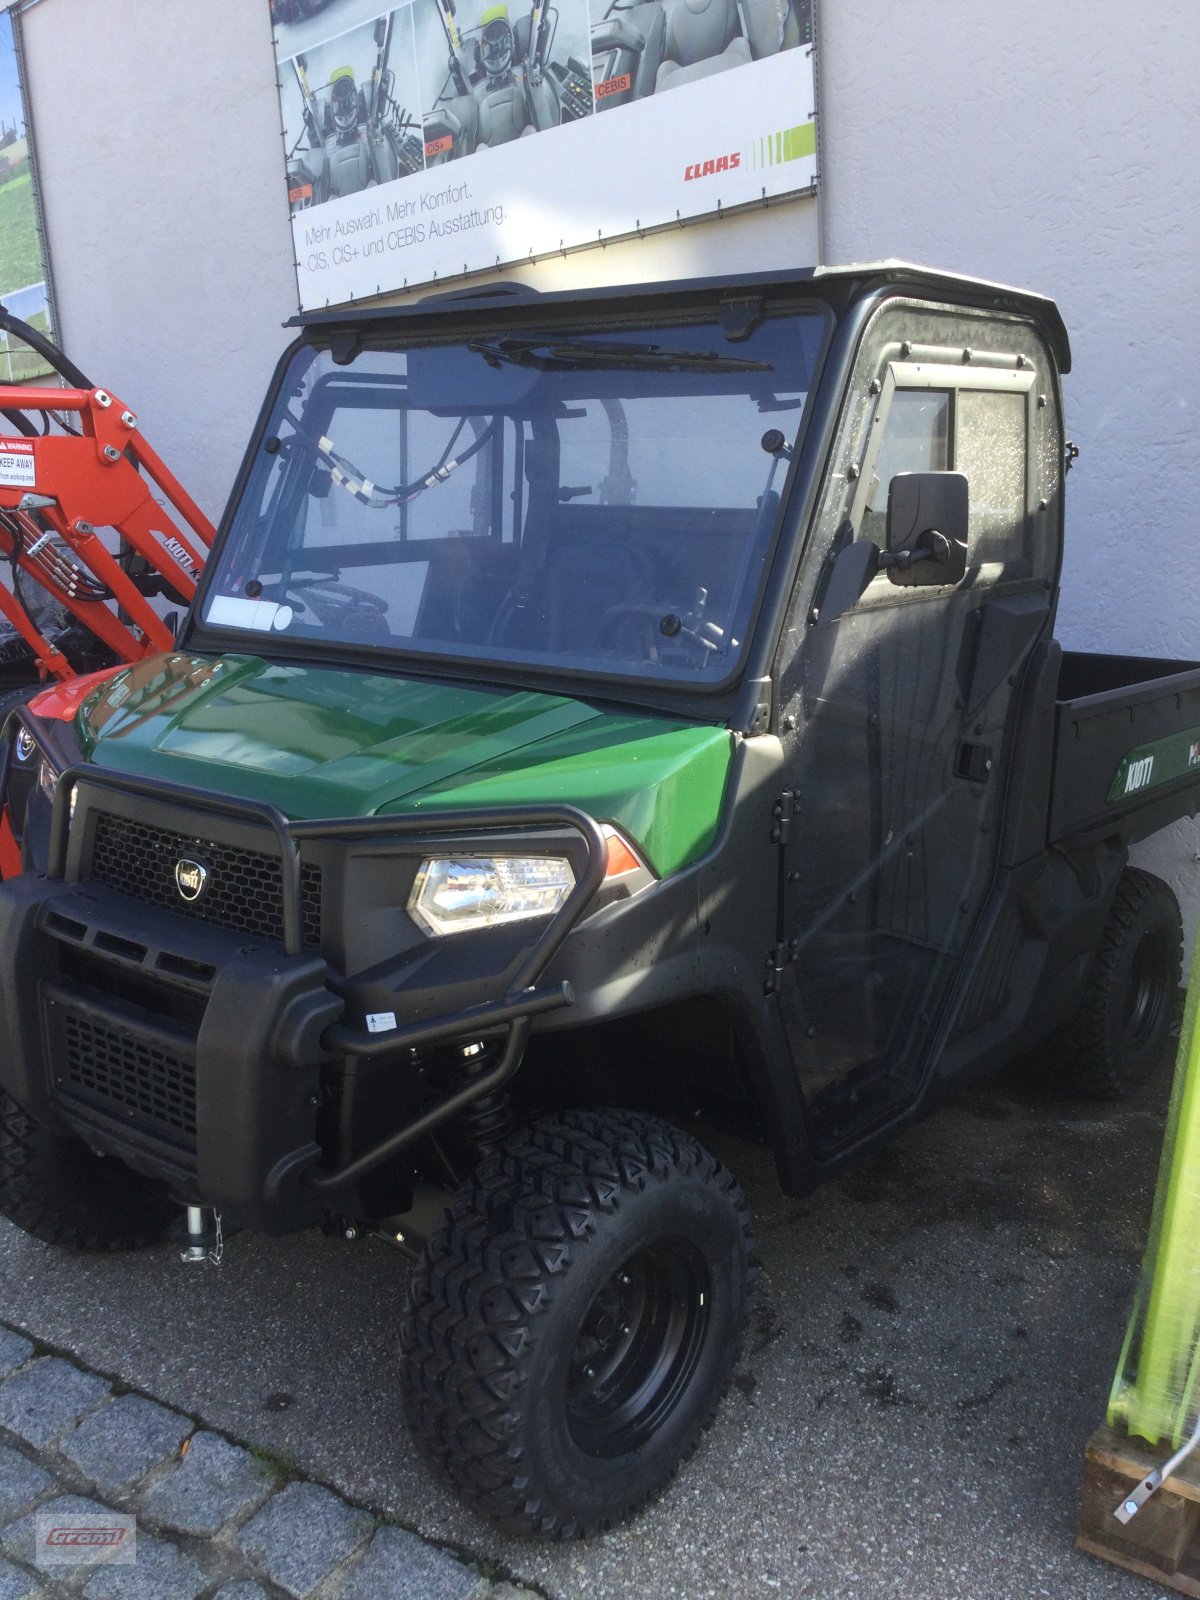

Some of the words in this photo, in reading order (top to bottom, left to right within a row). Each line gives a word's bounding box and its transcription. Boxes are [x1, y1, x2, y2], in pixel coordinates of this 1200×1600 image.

[598, 77, 627, 96] CEBIS
[427, 143, 444, 154] CIS+
[684, 152, 741, 182] CLAAS
[291, 189, 303, 199] CIS
[305, 226, 332, 246] Mehr
[334, 211, 383, 236] Auswahl.
[386, 198, 418, 222] Mehr
[420, 181, 473, 212] Komfort.
[307, 252, 330, 272] CIS,
[332, 244, 360, 266] CIS+
[363, 236, 385, 257] und
[387, 223, 426, 250] CEBIS
[428, 204, 508, 240] Ausstattung.
[6, 442, 33, 452] WARNING
[0, 457, 14, 468] KEEP
[16, 458, 33, 469] AWAY
[163, 536, 194, 568] KIOTI
[1124, 755, 1154, 793] KIOTI
